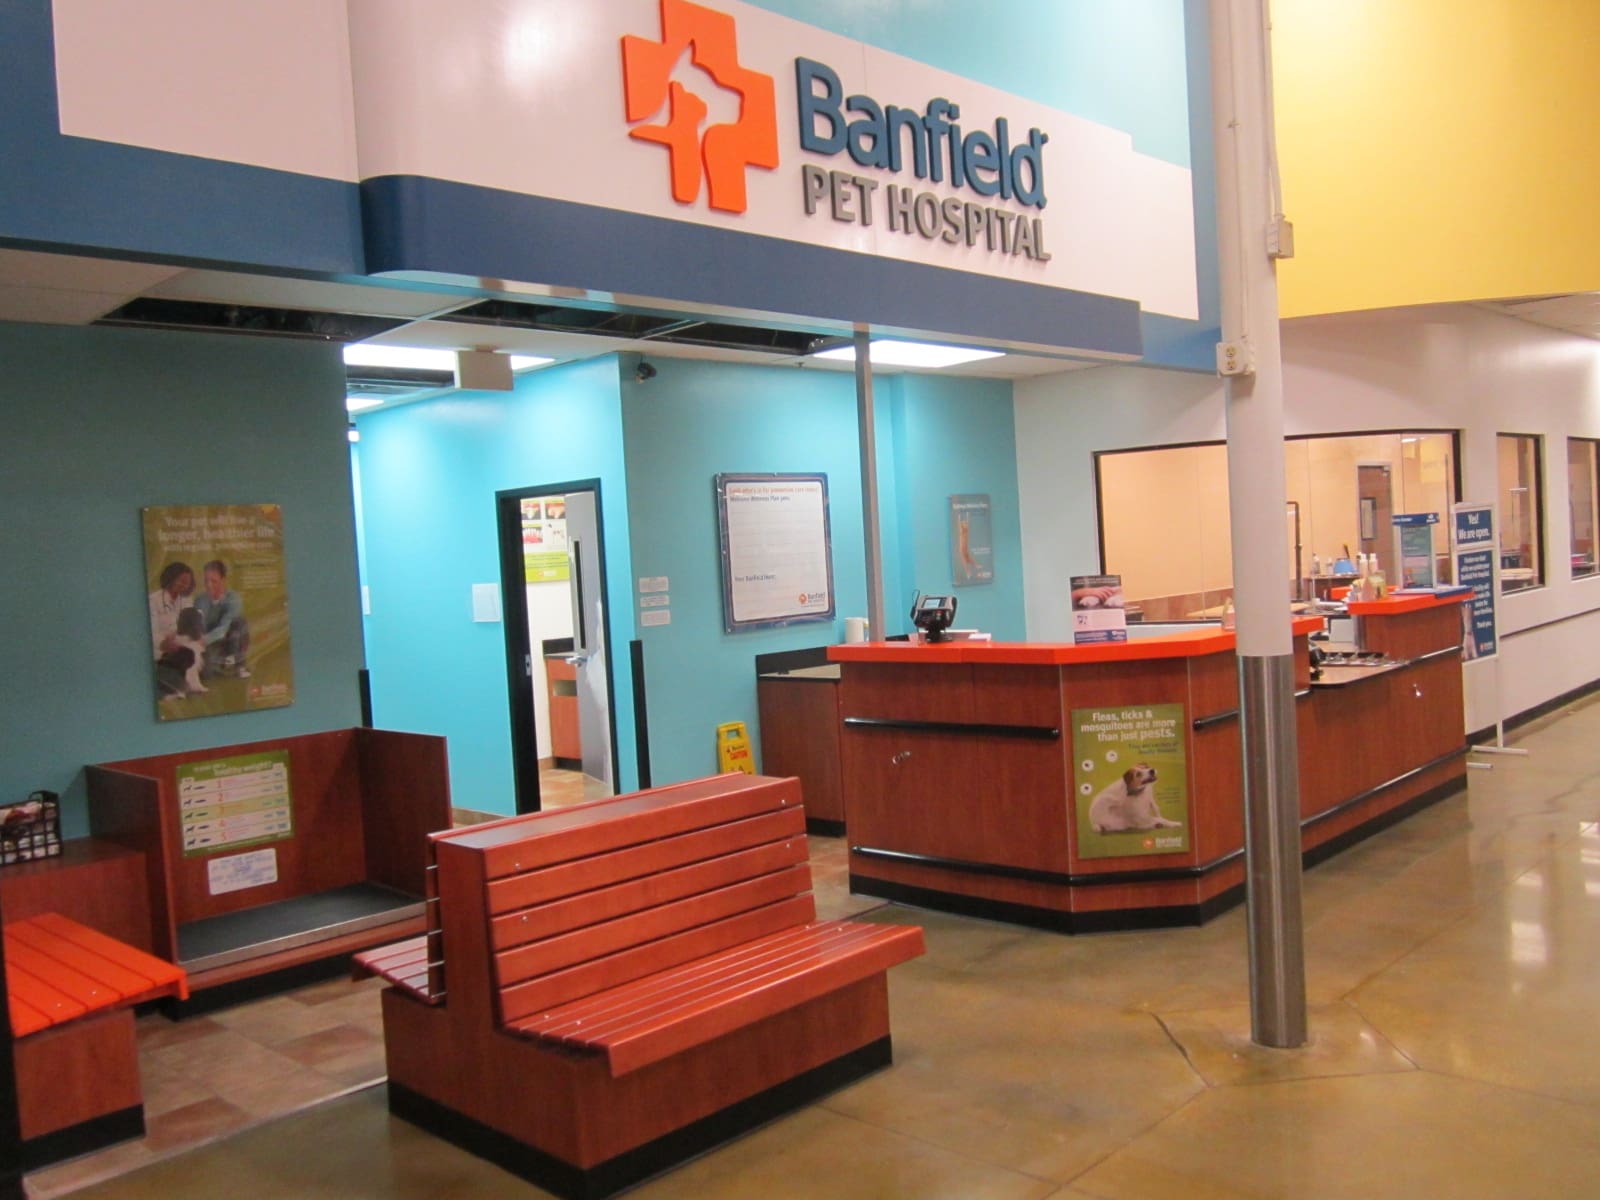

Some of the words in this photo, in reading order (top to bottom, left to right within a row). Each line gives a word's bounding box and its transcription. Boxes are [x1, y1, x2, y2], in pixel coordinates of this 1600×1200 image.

[795, 56, 1048, 209] Banfield
[803, 164, 878, 227] PET
[887, 183, 1052, 262] HOSPITAL
[1092, 711, 1119, 723] Fleas,
[1121, 709, 1143, 720] ticks
[1080, 721, 1134, 733] mosquitoes
[1152, 719, 1176, 728] more
[1097, 732, 1119, 742] than
[1120, 731, 1138, 742] just
[1139, 727, 1175, 741] pests.
